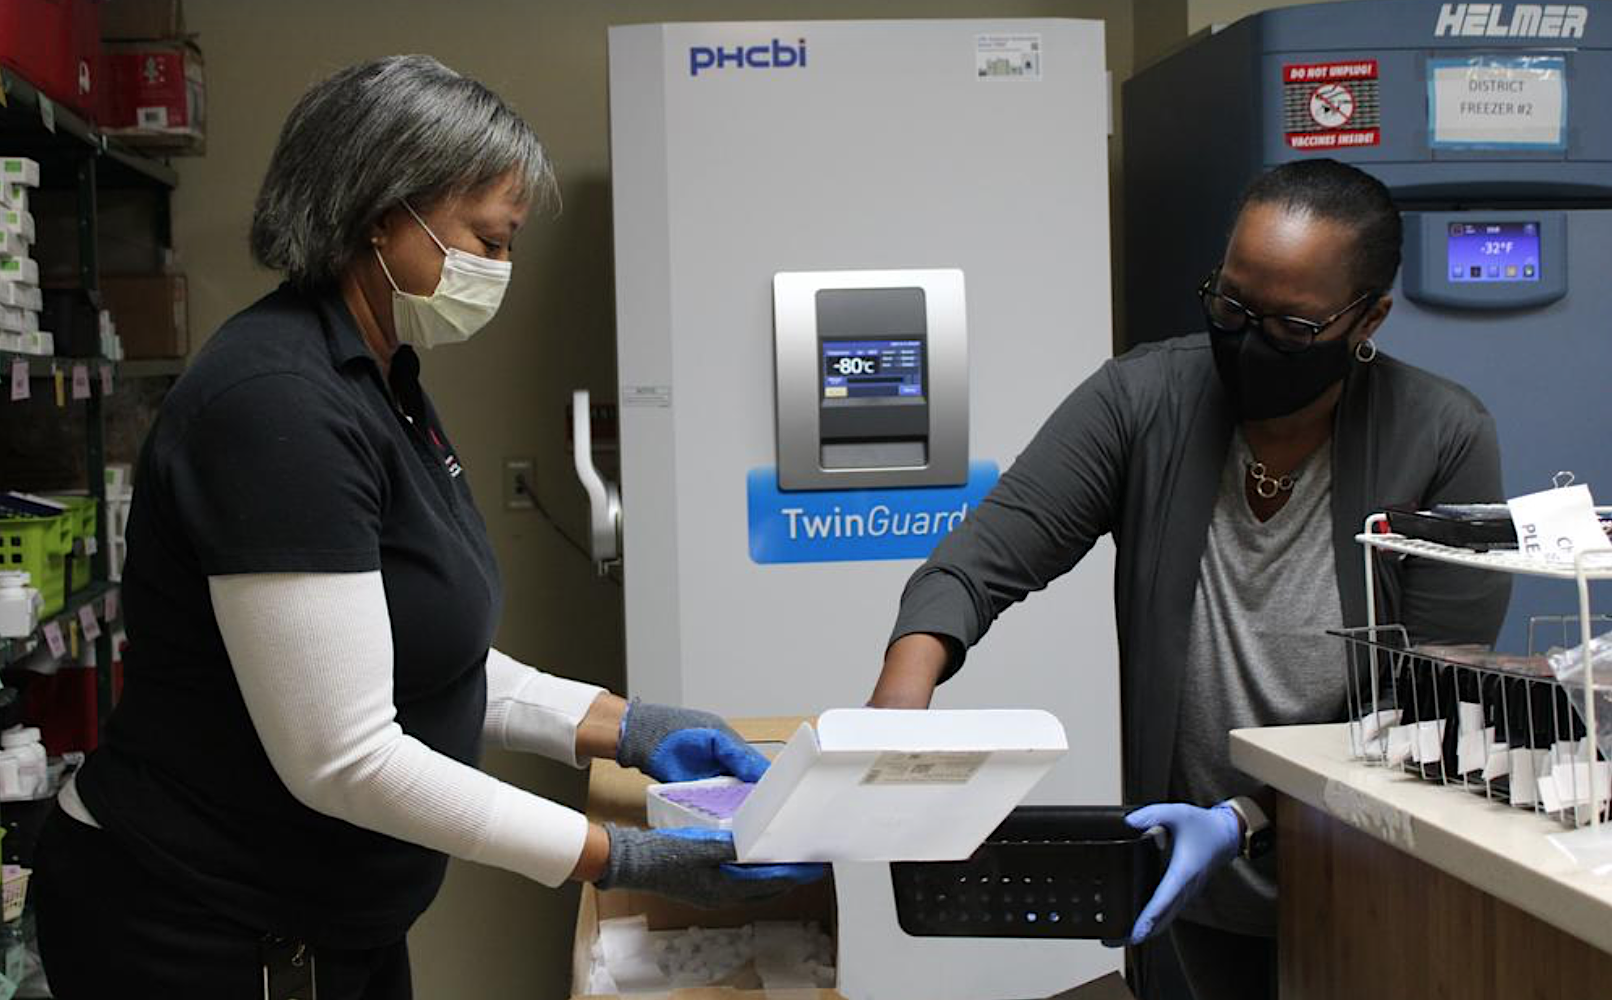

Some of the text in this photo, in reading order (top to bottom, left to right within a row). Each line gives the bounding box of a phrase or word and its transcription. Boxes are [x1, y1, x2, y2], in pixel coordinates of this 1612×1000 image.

[1434, 3, 1588, 38] HELMER
[1290, 67, 1306, 79] DO
[1307, 66, 1328, 78] NOT
[1469, 79, 1525, 93] DISTRICT
[1460, 101, 1533, 116] FREEZER #2
[1291, 134, 1337, 147] VACCINES
[781, 502, 968, 540] TwinGuard
